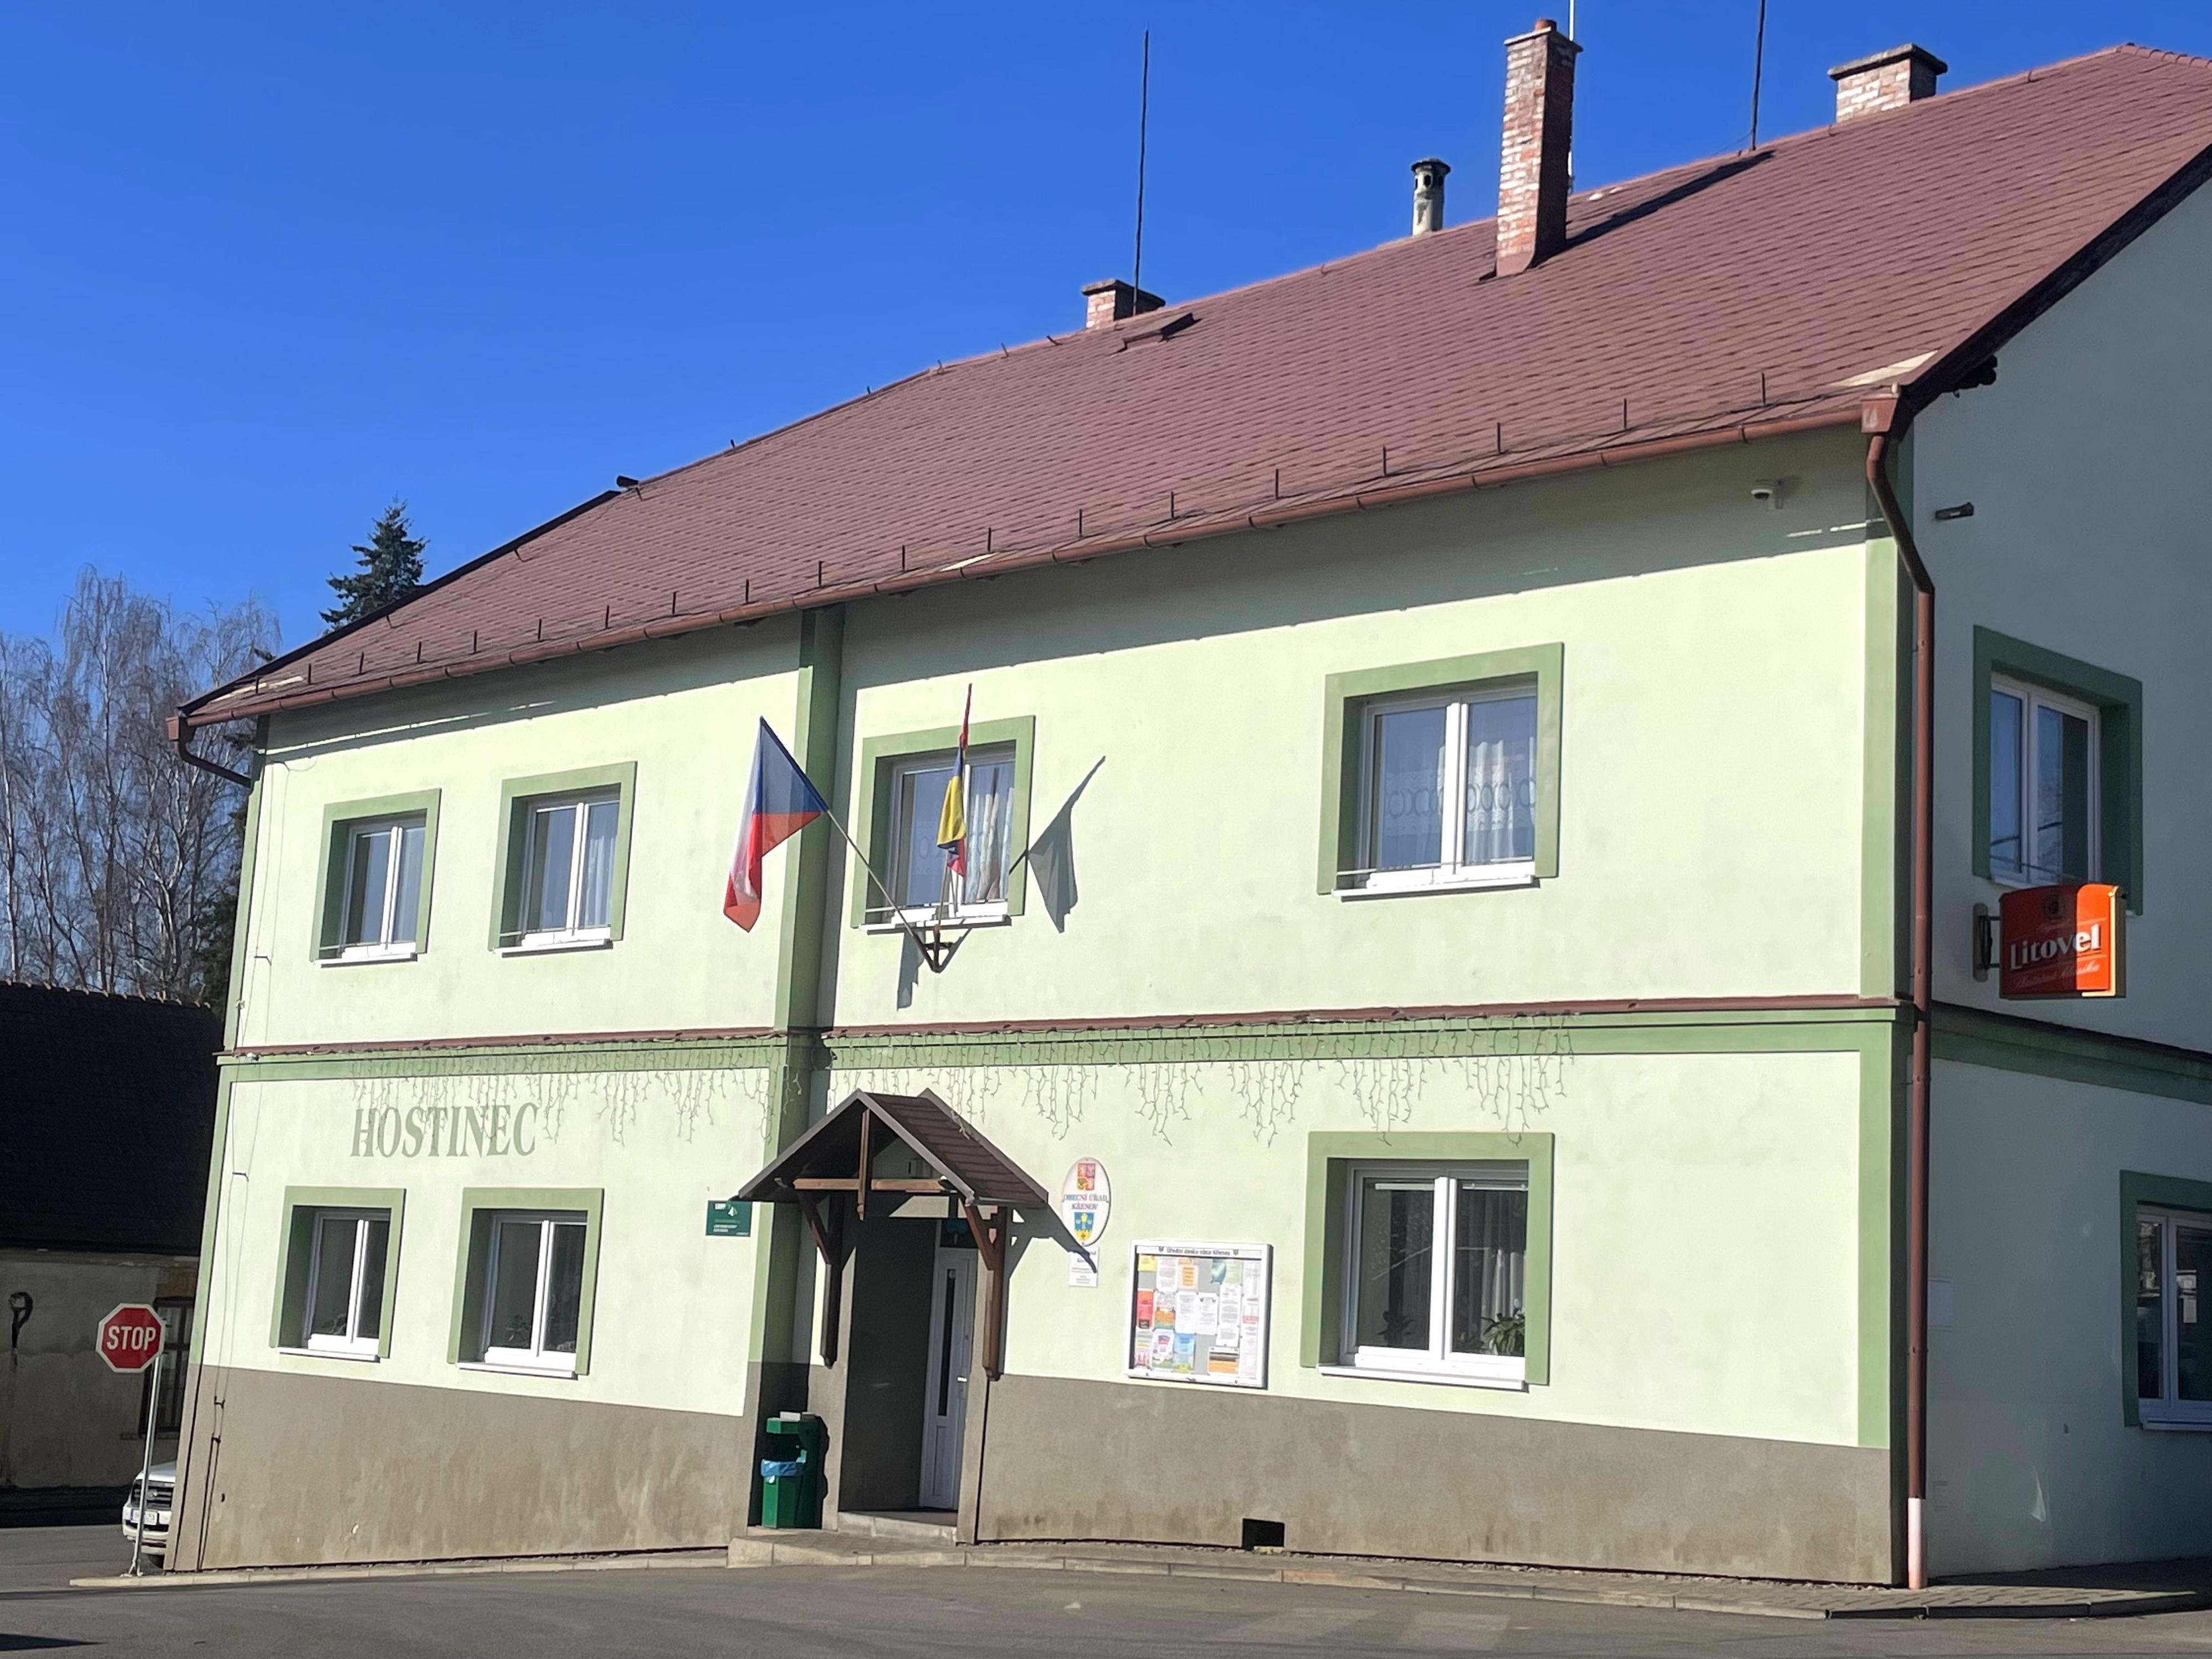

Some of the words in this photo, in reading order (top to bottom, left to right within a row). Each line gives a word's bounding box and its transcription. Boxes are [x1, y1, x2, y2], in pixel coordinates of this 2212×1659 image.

[2010, 924, 2101, 971] Litovel
[350, 1102, 538, 1157] HOSTINEC
[106, 1326, 156, 1350] STOP
